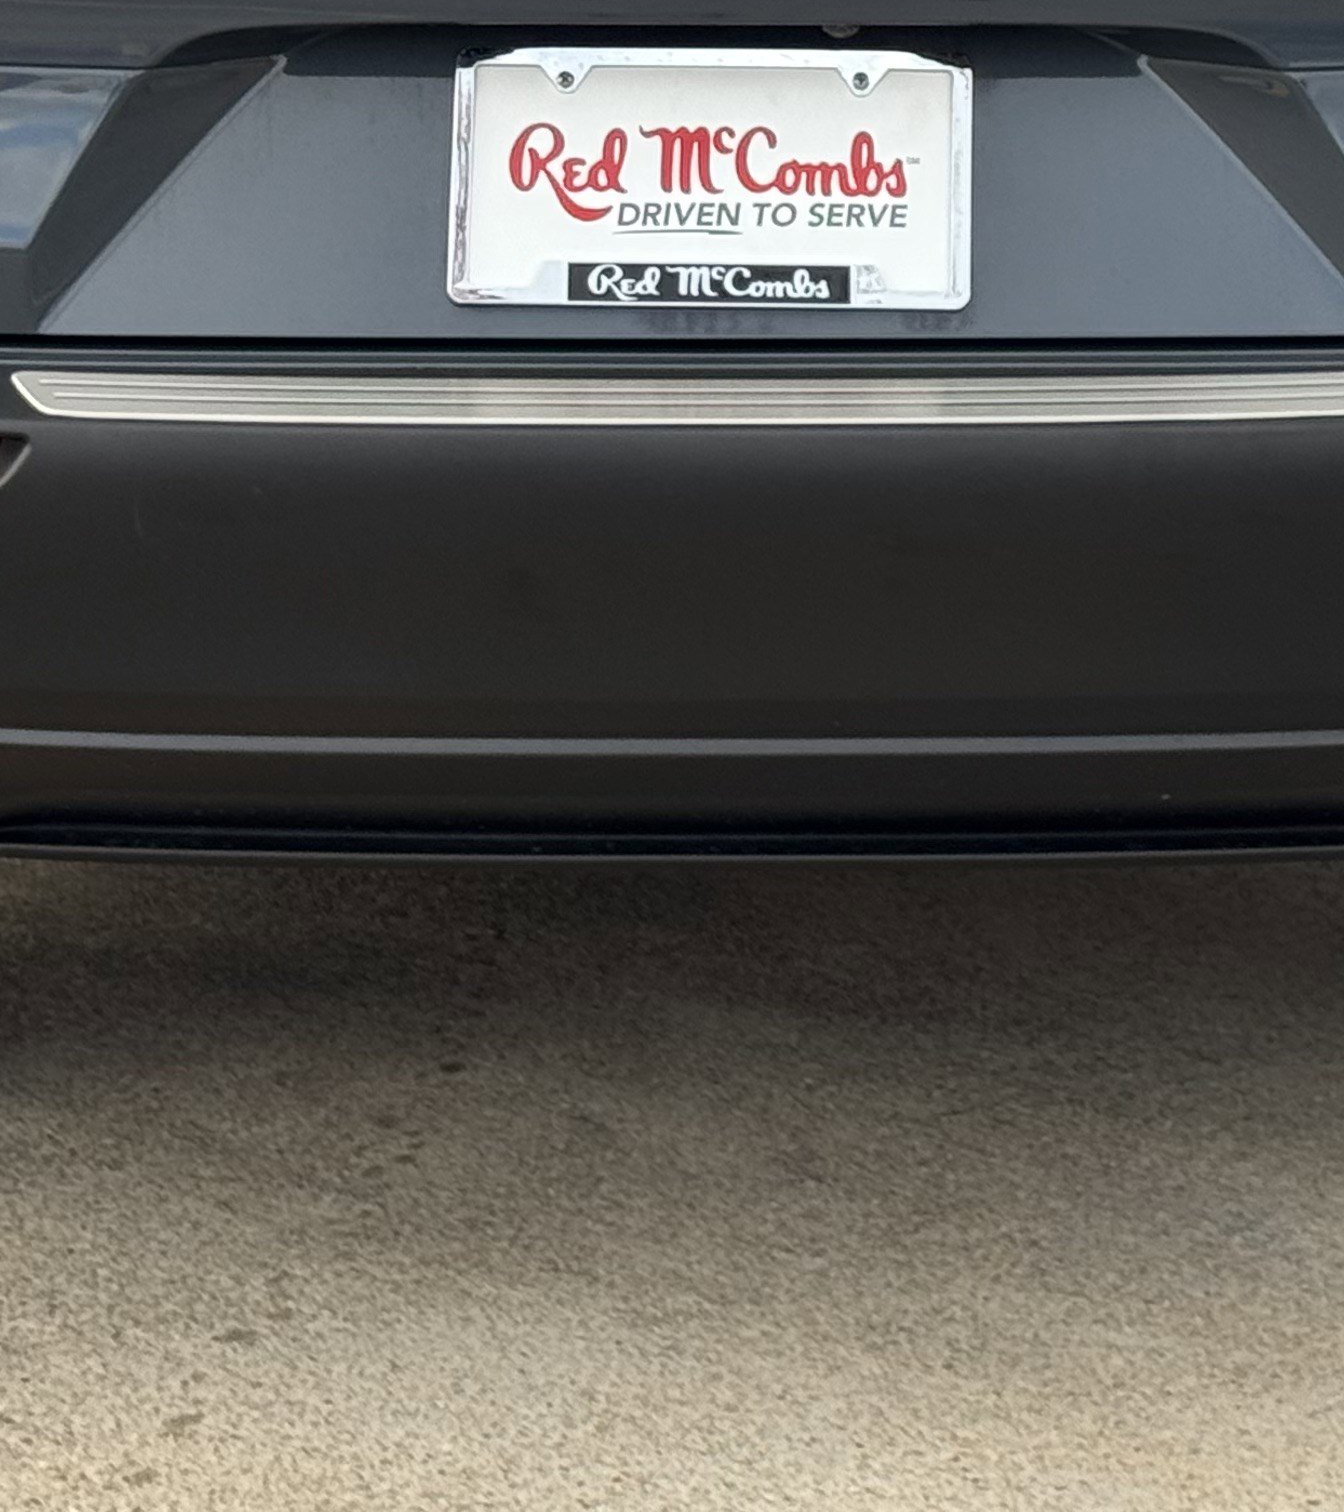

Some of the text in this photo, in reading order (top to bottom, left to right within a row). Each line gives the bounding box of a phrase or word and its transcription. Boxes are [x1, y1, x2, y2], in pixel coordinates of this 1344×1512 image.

[509, 122, 628, 222] Red
[617, 202, 908, 228] DRIVEN TO SERVE
[587, 264, 661, 301] Red
